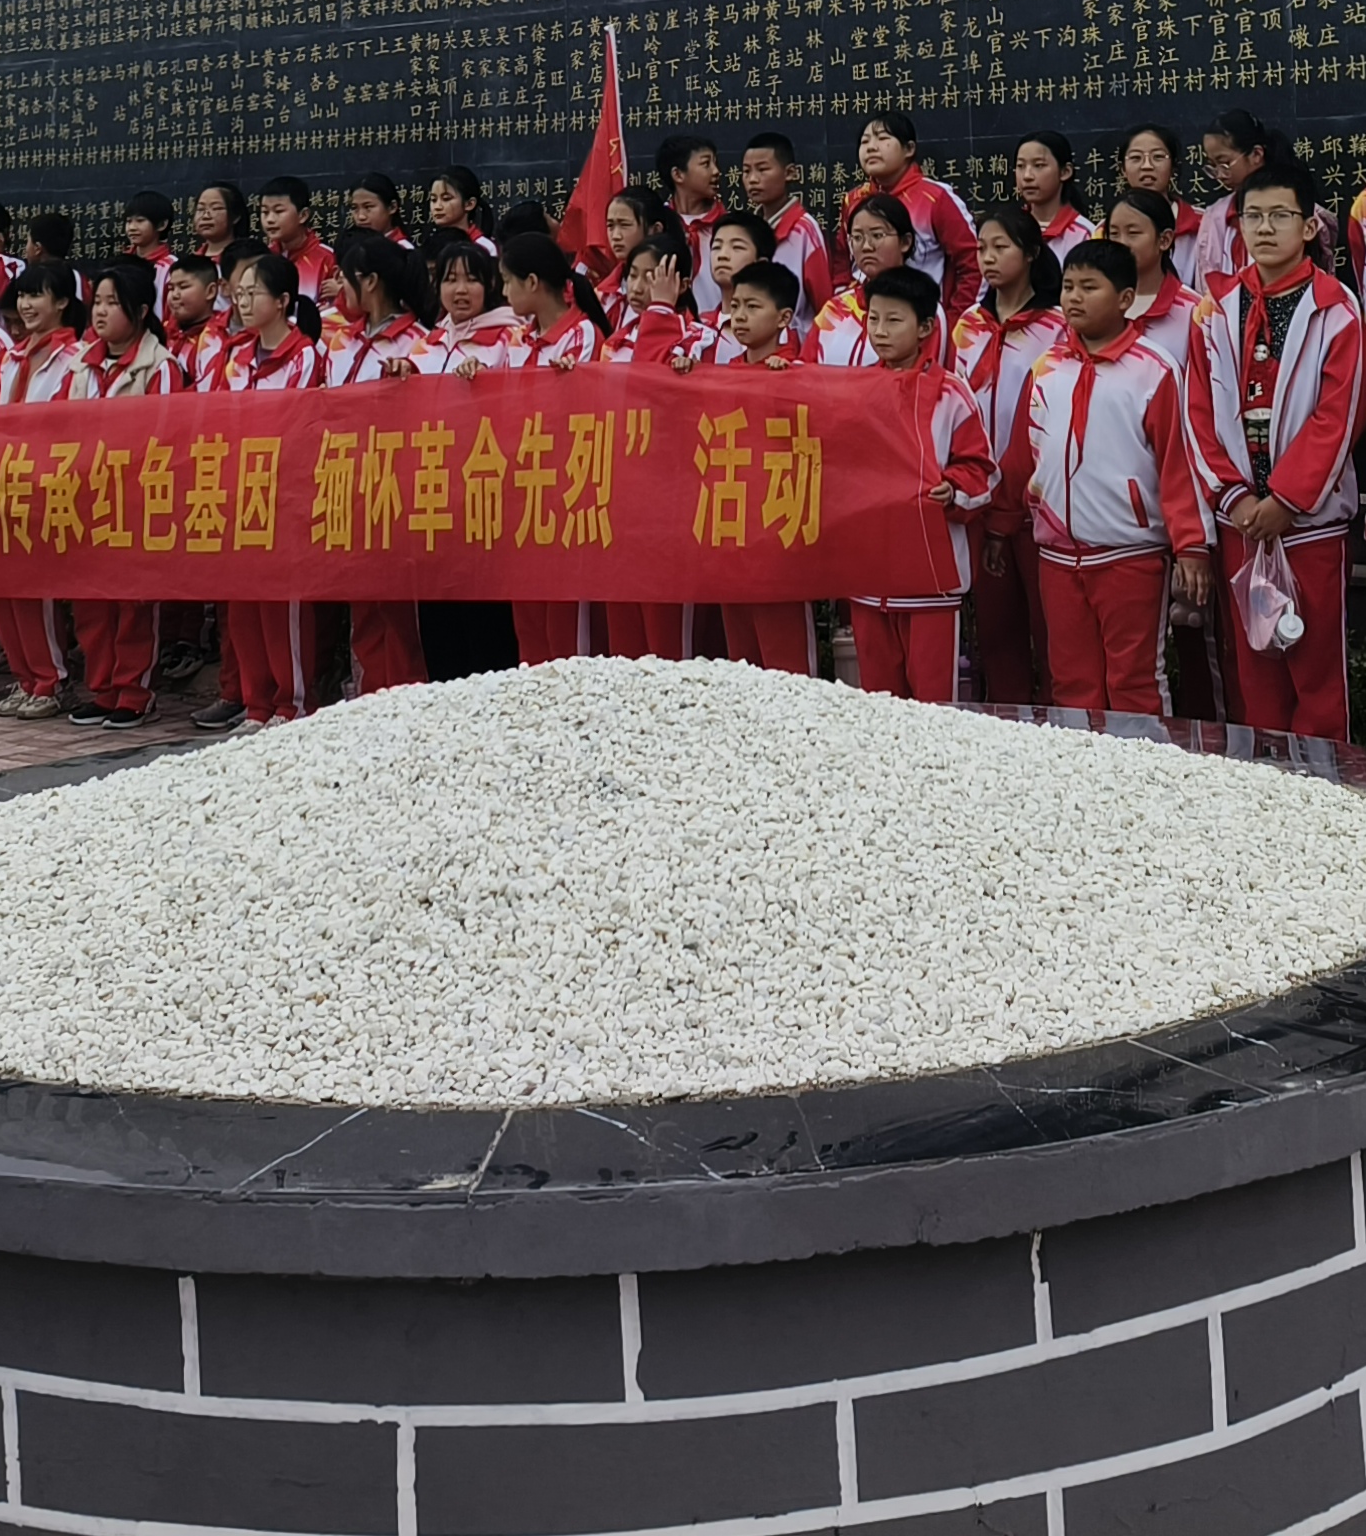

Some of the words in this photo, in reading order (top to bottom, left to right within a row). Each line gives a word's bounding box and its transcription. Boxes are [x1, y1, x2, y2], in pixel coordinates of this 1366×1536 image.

[626, 12, 642, 127] 米山村
[644, 11, 661, 126] 富岭官庄村
[664, 8, 680, 124] 崖下村
[684, 7, 705, 123] 书堂旺村
[703, 4, 721, 121] 李家大峪村
[723, 3, 741, 120] 马站村
[742, 0, 761, 119] 神林店村
[1318, 136, 1348, 215] 邱兴才
[310, 408, 652, 552] 缅怀革命先烈”
[692, 404, 822, 548] 活动
